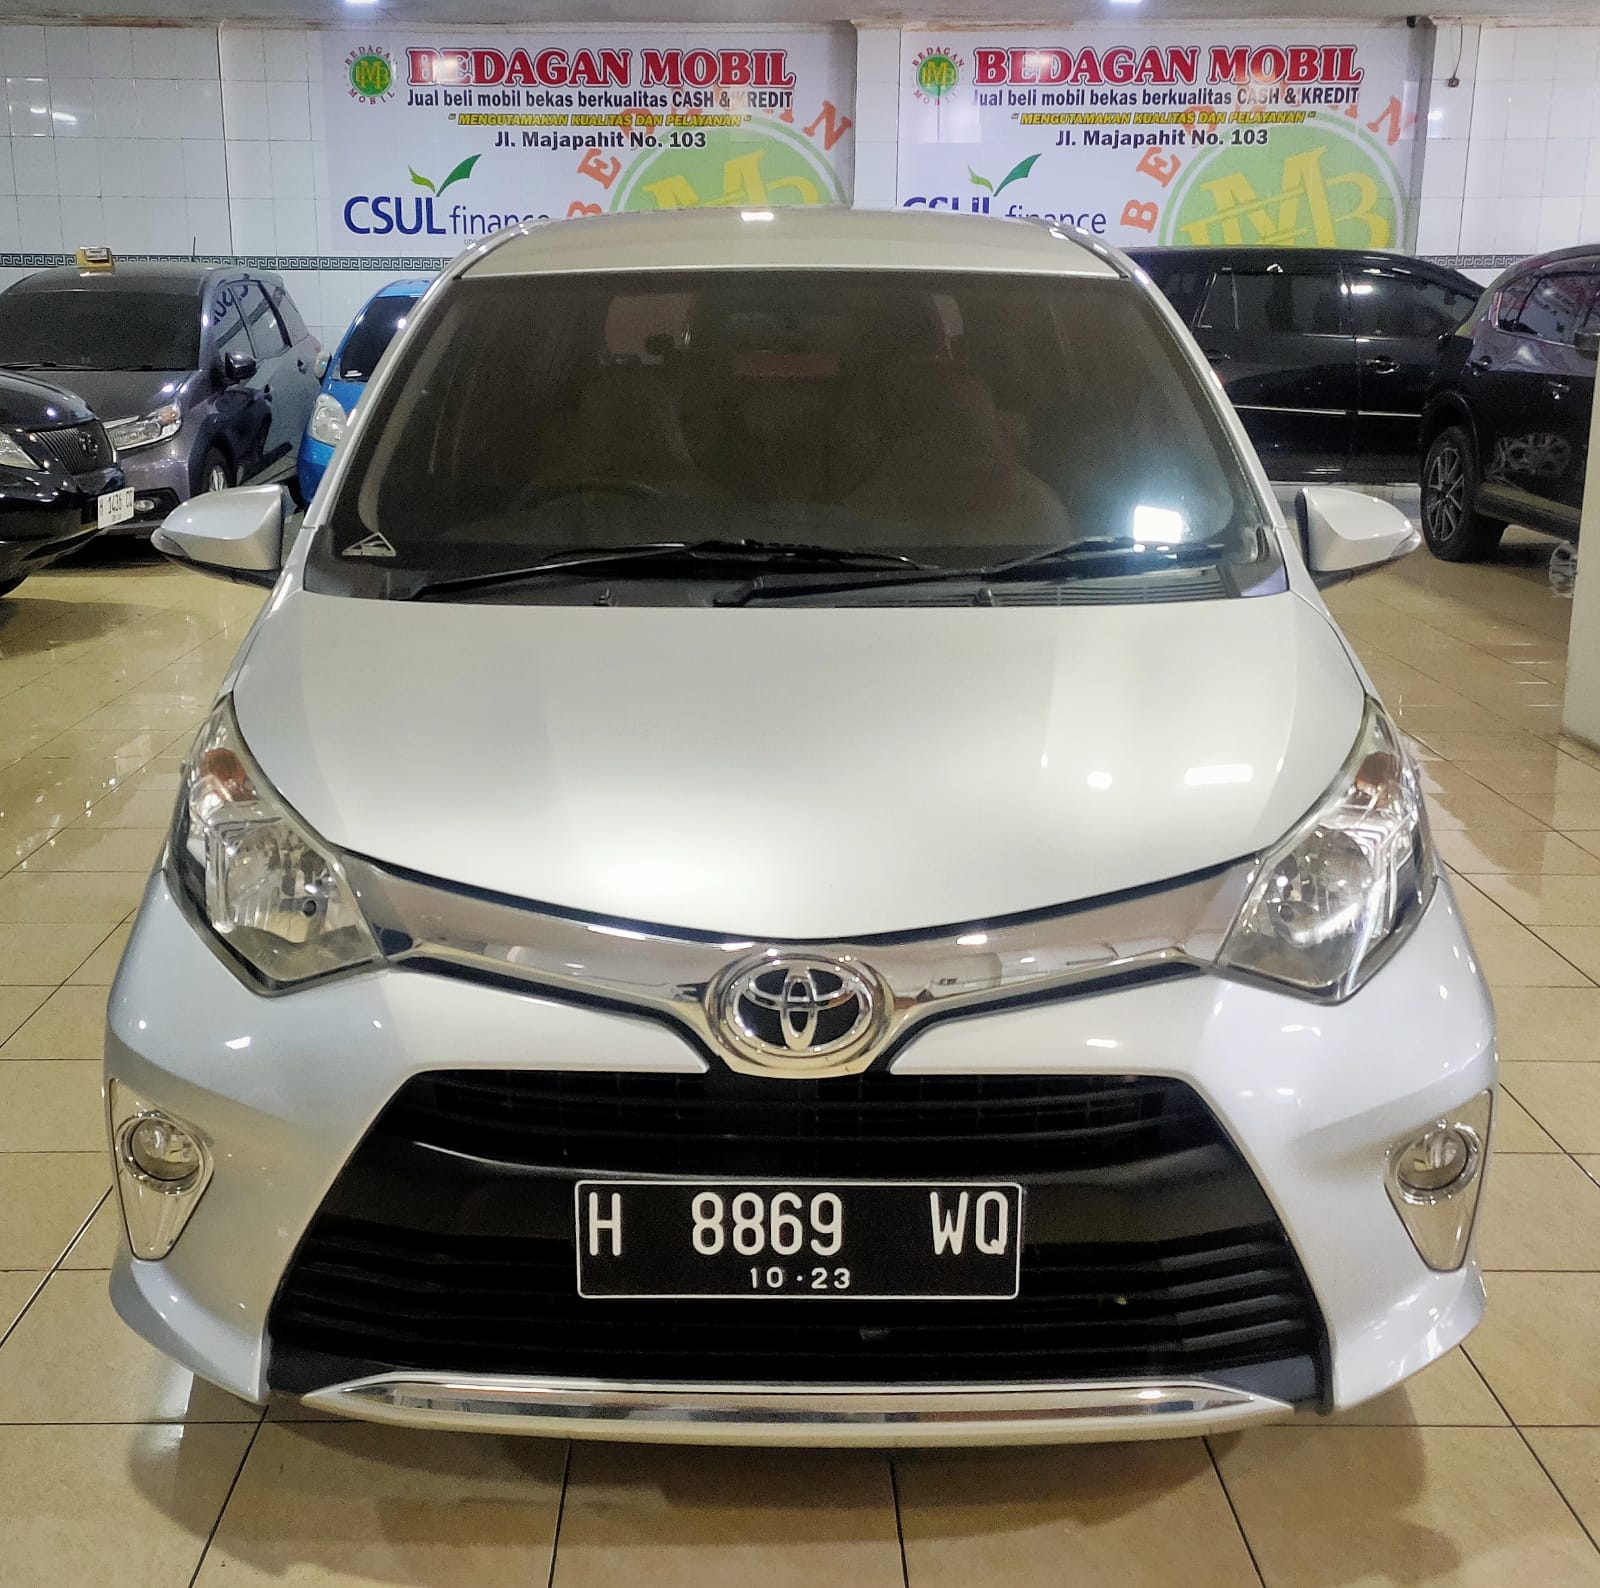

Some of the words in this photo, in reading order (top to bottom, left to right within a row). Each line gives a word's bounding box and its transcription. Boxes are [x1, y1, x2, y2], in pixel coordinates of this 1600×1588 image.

[345, 45, 398, 66] BEDAGA
[912, 46, 965, 67] BEDAGAN
[1207, 44, 1365, 85] MOBIL
[640, 48, 797, 88] MOBIL
[407, 89, 439, 107] Jual
[444, 89, 473, 106] beli
[477, 89, 521, 107] mobil
[526, 90, 574, 107] bekas
[578, 90, 668, 108] berkualitas
[673, 91, 714, 108] CASH
[736, 91, 793, 108] REDIT
[1008, 89, 1037, 106] beli
[1041, 88, 1085, 106] mobil
[1089, 88, 1137, 106] bekas
[1142, 87, 1232, 105] berkualitas
[1284, 87, 1297, 104] &
[1301, 87, 1360, 104] KREDIT
[457, 113, 568, 126] MENGUTAMAKAN
[570, 113, 633, 126] KUALITAS
[635, 113, 663, 126] DAN
[665, 114, 741, 127] PELAYANAN
[1020, 112, 1131, 125] MENGUTAMAKAN
[1132, 111, 1195, 124] KUALITAS
[1199, 111, 1226, 124] DAN
[1228, 111, 1306, 124] PELAYANAN
[495, 131, 515, 148] Jl.
[522, 131, 624, 150] Majapahit
[630, 132, 663, 148] No.
[669, 132, 706, 148] 103
[1056, 130, 1077, 147] Jl.
[1083, 129, 1185, 149] Majapahit
[1191, 129, 1224, 146] No.
[1231, 128, 1268, 145] 103
[343, 196, 447, 235] CSUL
[588, 1192, 621, 1256] H
[691, 1192, 843, 1256] 8869
[929, 1191, 1009, 1256] WQ
